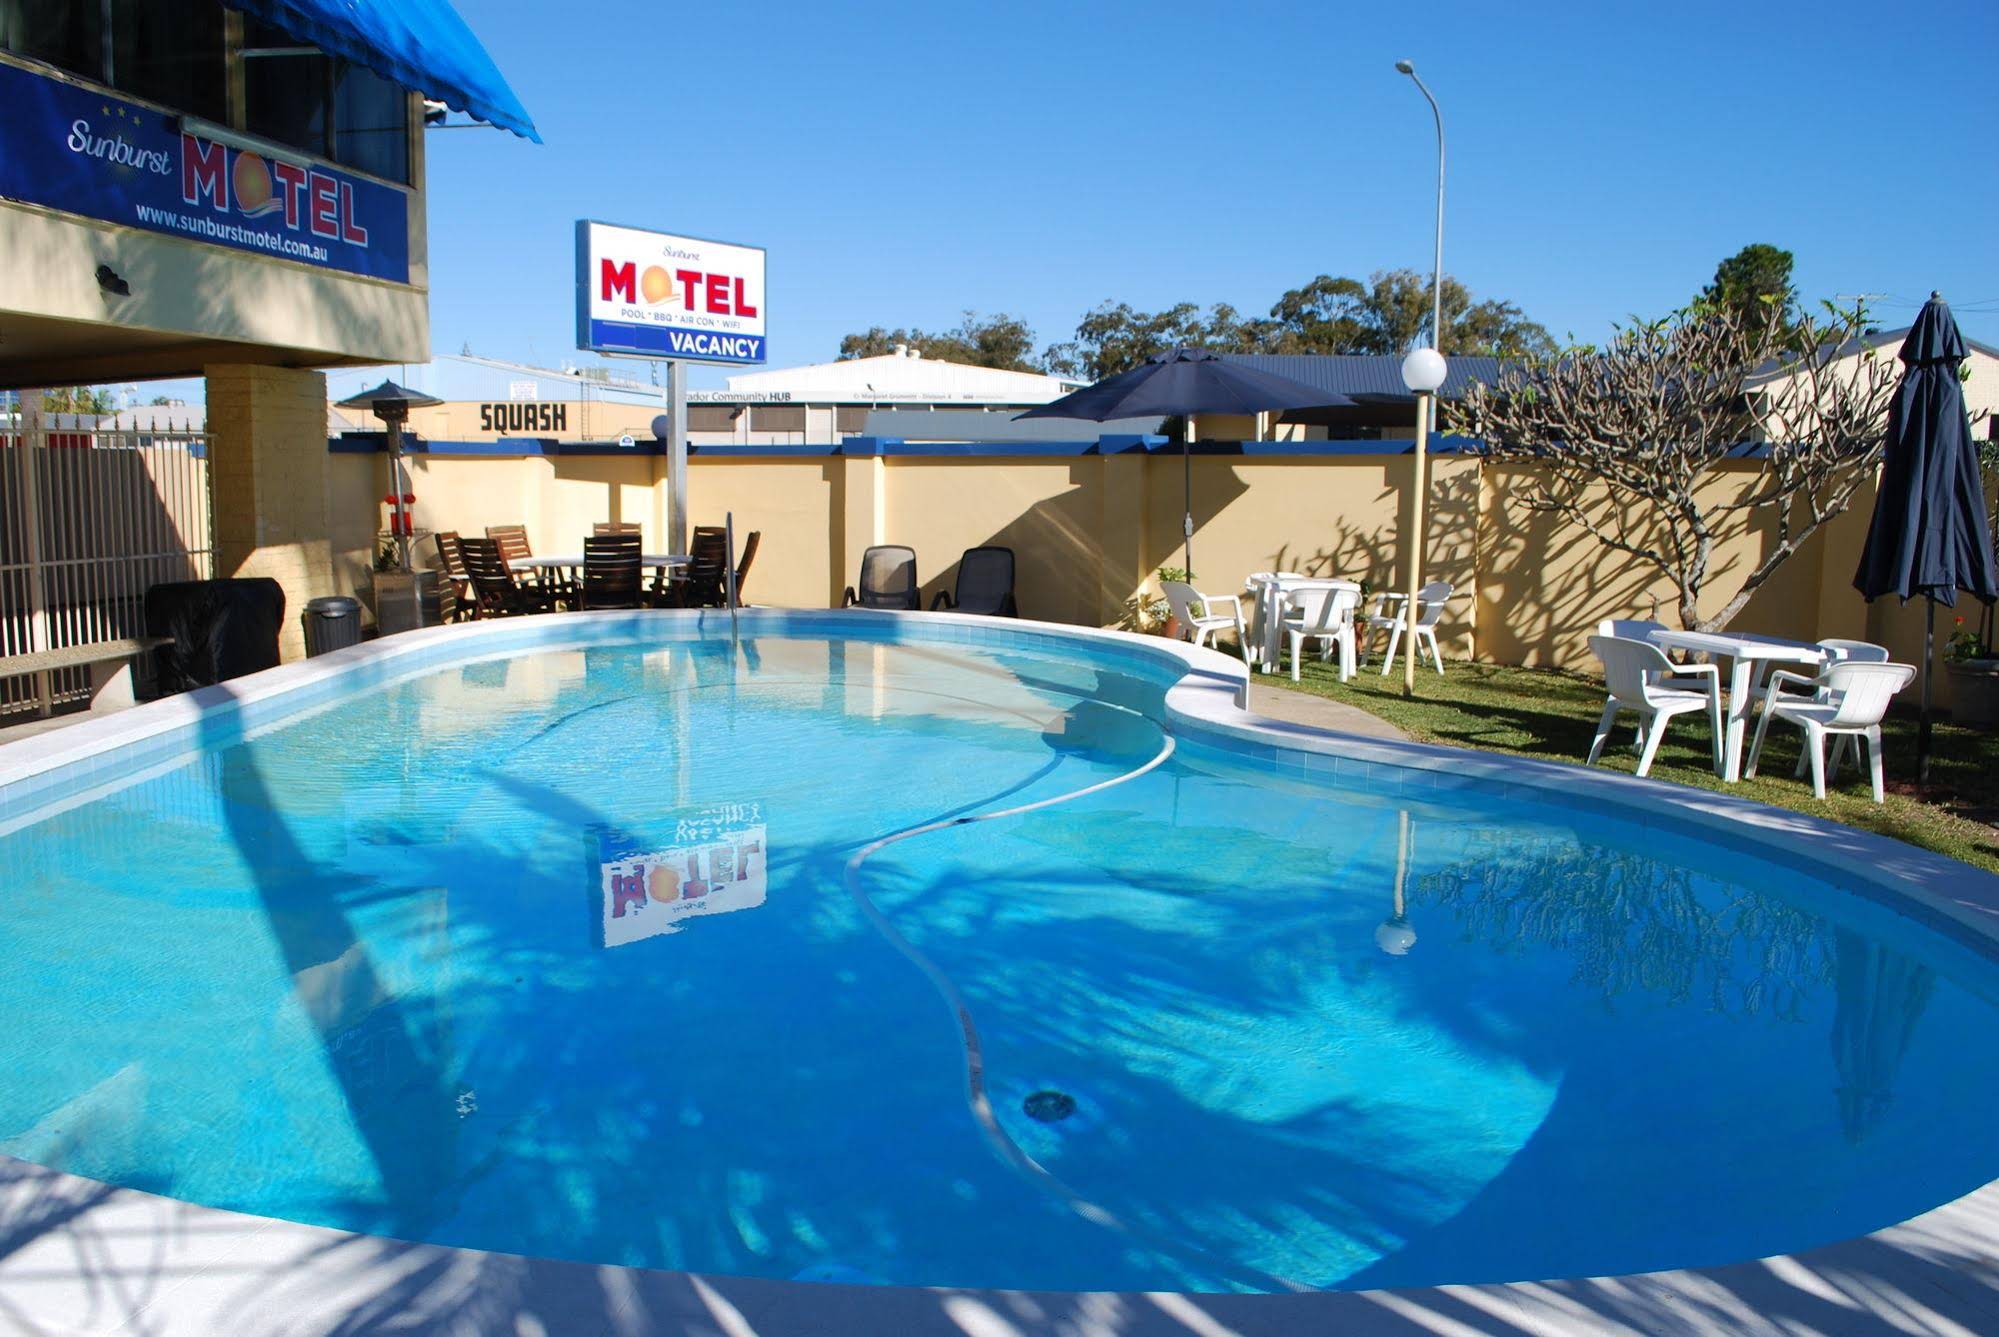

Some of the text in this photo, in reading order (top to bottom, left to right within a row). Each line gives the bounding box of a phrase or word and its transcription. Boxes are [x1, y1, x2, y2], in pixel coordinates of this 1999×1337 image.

[67, 119, 172, 176] Sunburst
[181, 131, 368, 248] MOTEL
[136, 204, 328, 262] www.sunburstmotel.com.au
[601, 258, 757, 319] MOTEL
[621, 308, 646, 320] POOL
[653, 311, 672, 322] BBQ
[680, 315, 694, 325] AIR
[696, 317, 715, 327] CON
[670, 331, 759, 358] VACANCY
[480, 403, 567, 436] SQUASH
[711, 391, 768, 403] Community
[769, 392, 791, 401] HUB
